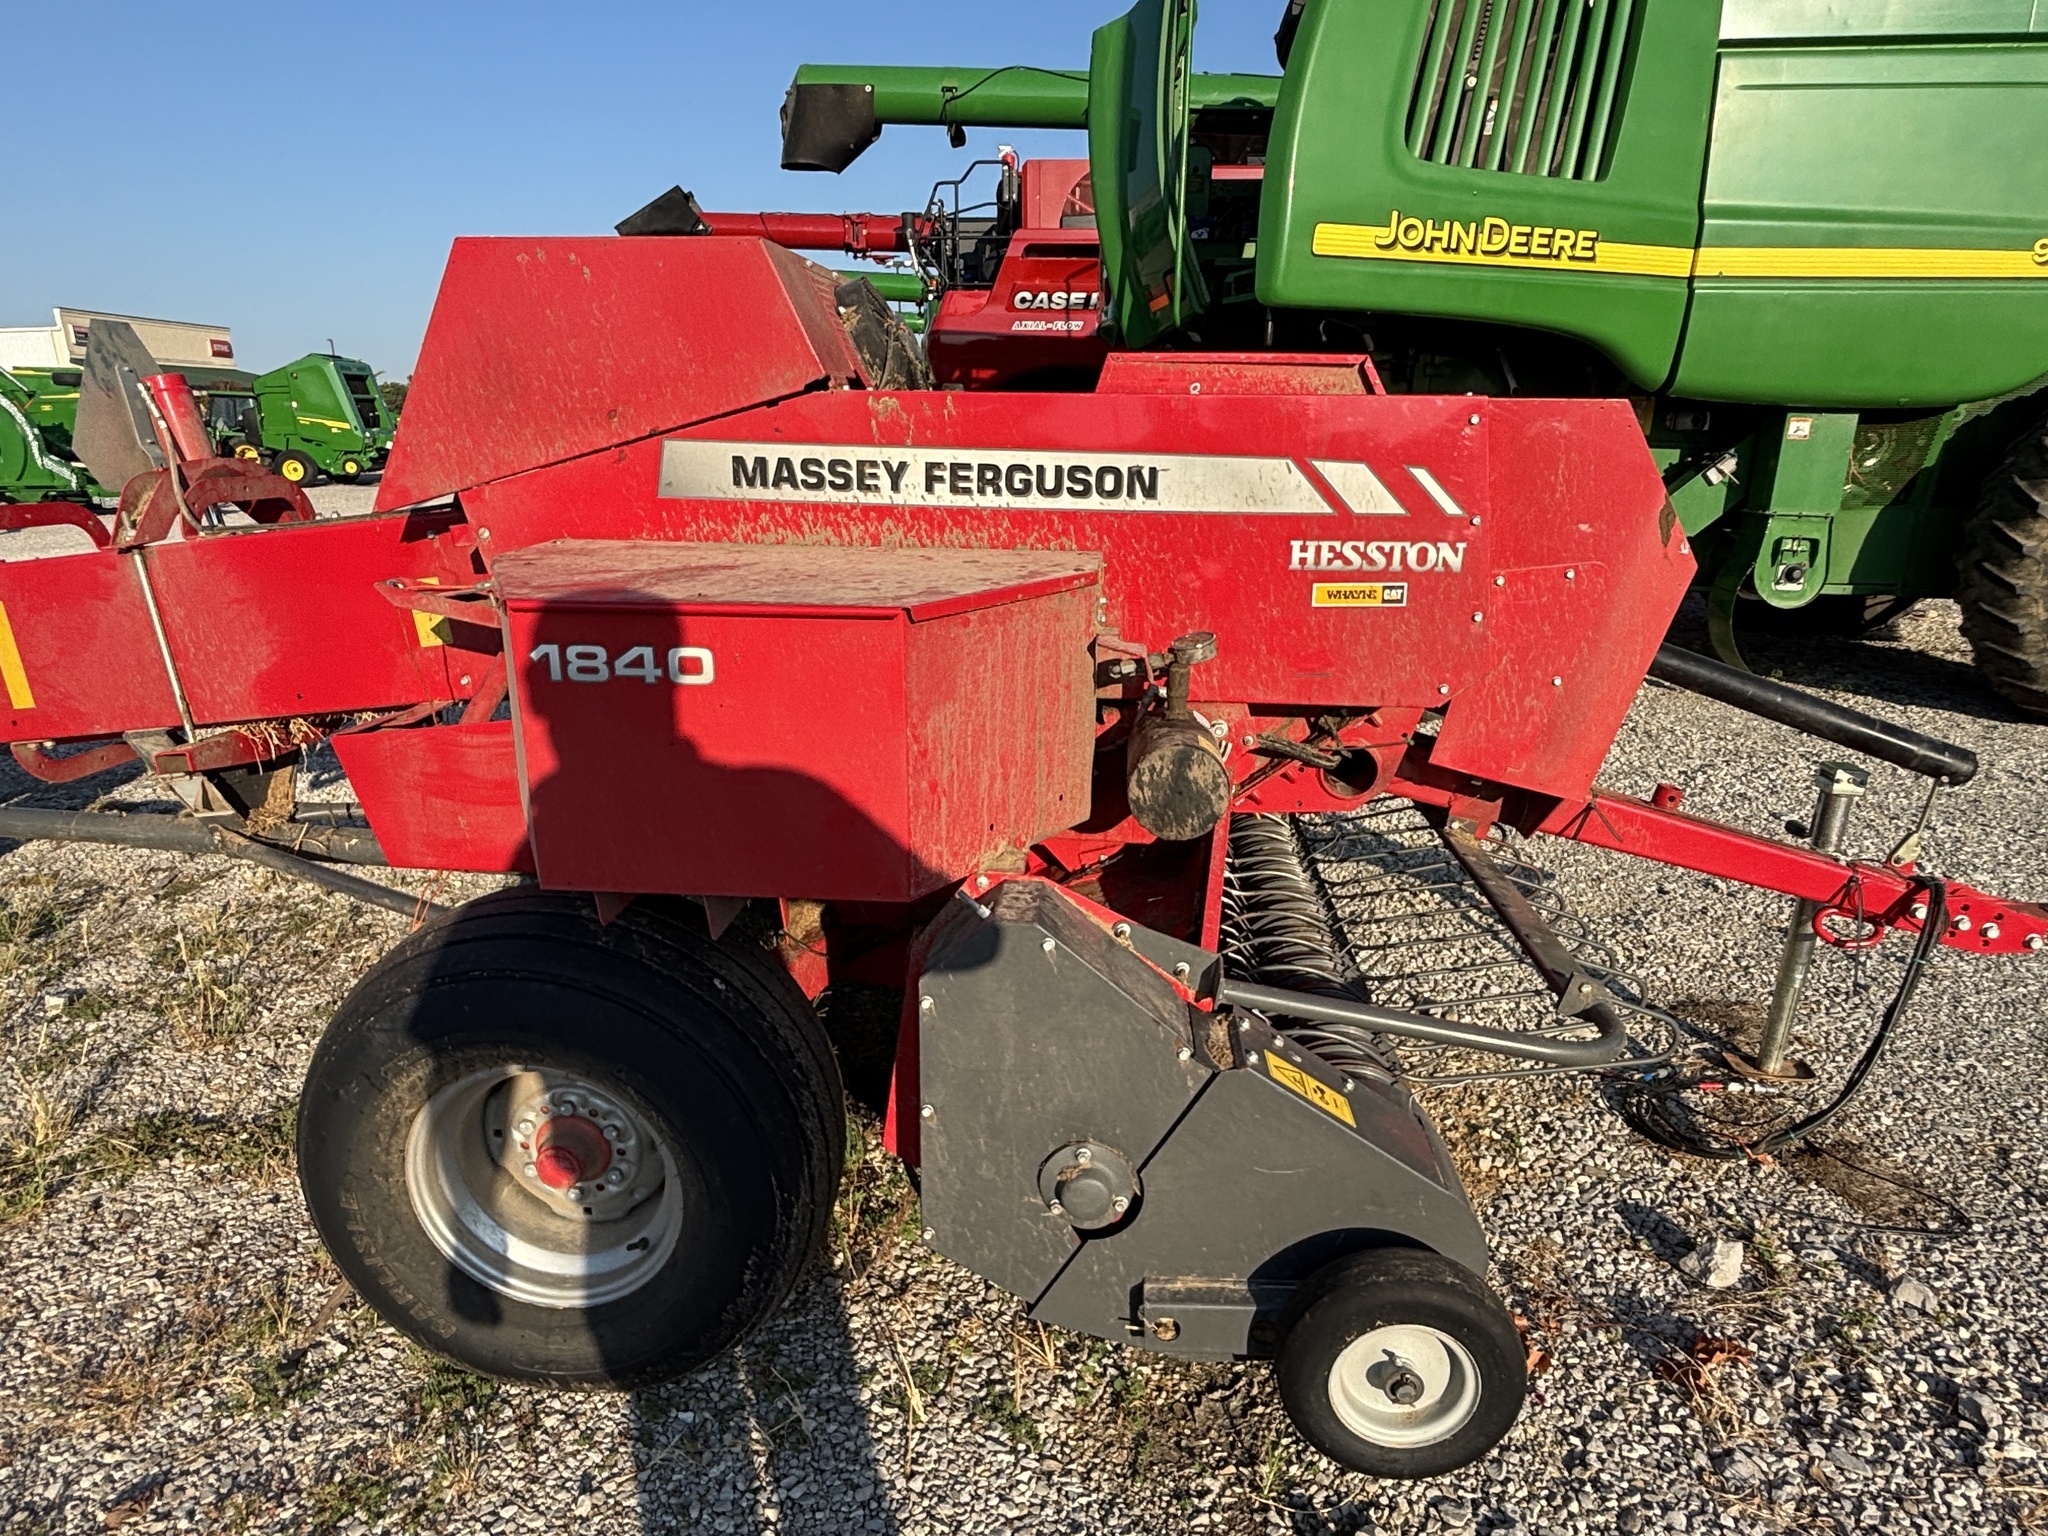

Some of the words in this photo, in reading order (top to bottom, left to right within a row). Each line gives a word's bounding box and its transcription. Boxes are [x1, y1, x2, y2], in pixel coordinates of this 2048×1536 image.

[1375, 210, 1477, 252] JOHN
[1480, 216, 1599, 261] DEERE
[1014, 291, 1087, 310] CASE
[1011, 321, 1084, 331] AXIAL-FLOW
[731, 454, 909, 492] MASSEY
[923, 461, 1159, 500] FERGUSON
[1288, 540, 1467, 573] HESSTON
[1326, 589, 1378, 600] WHAYNE
[1383, 588, 1403, 600] CAT
[529, 643, 715, 685] 1840
